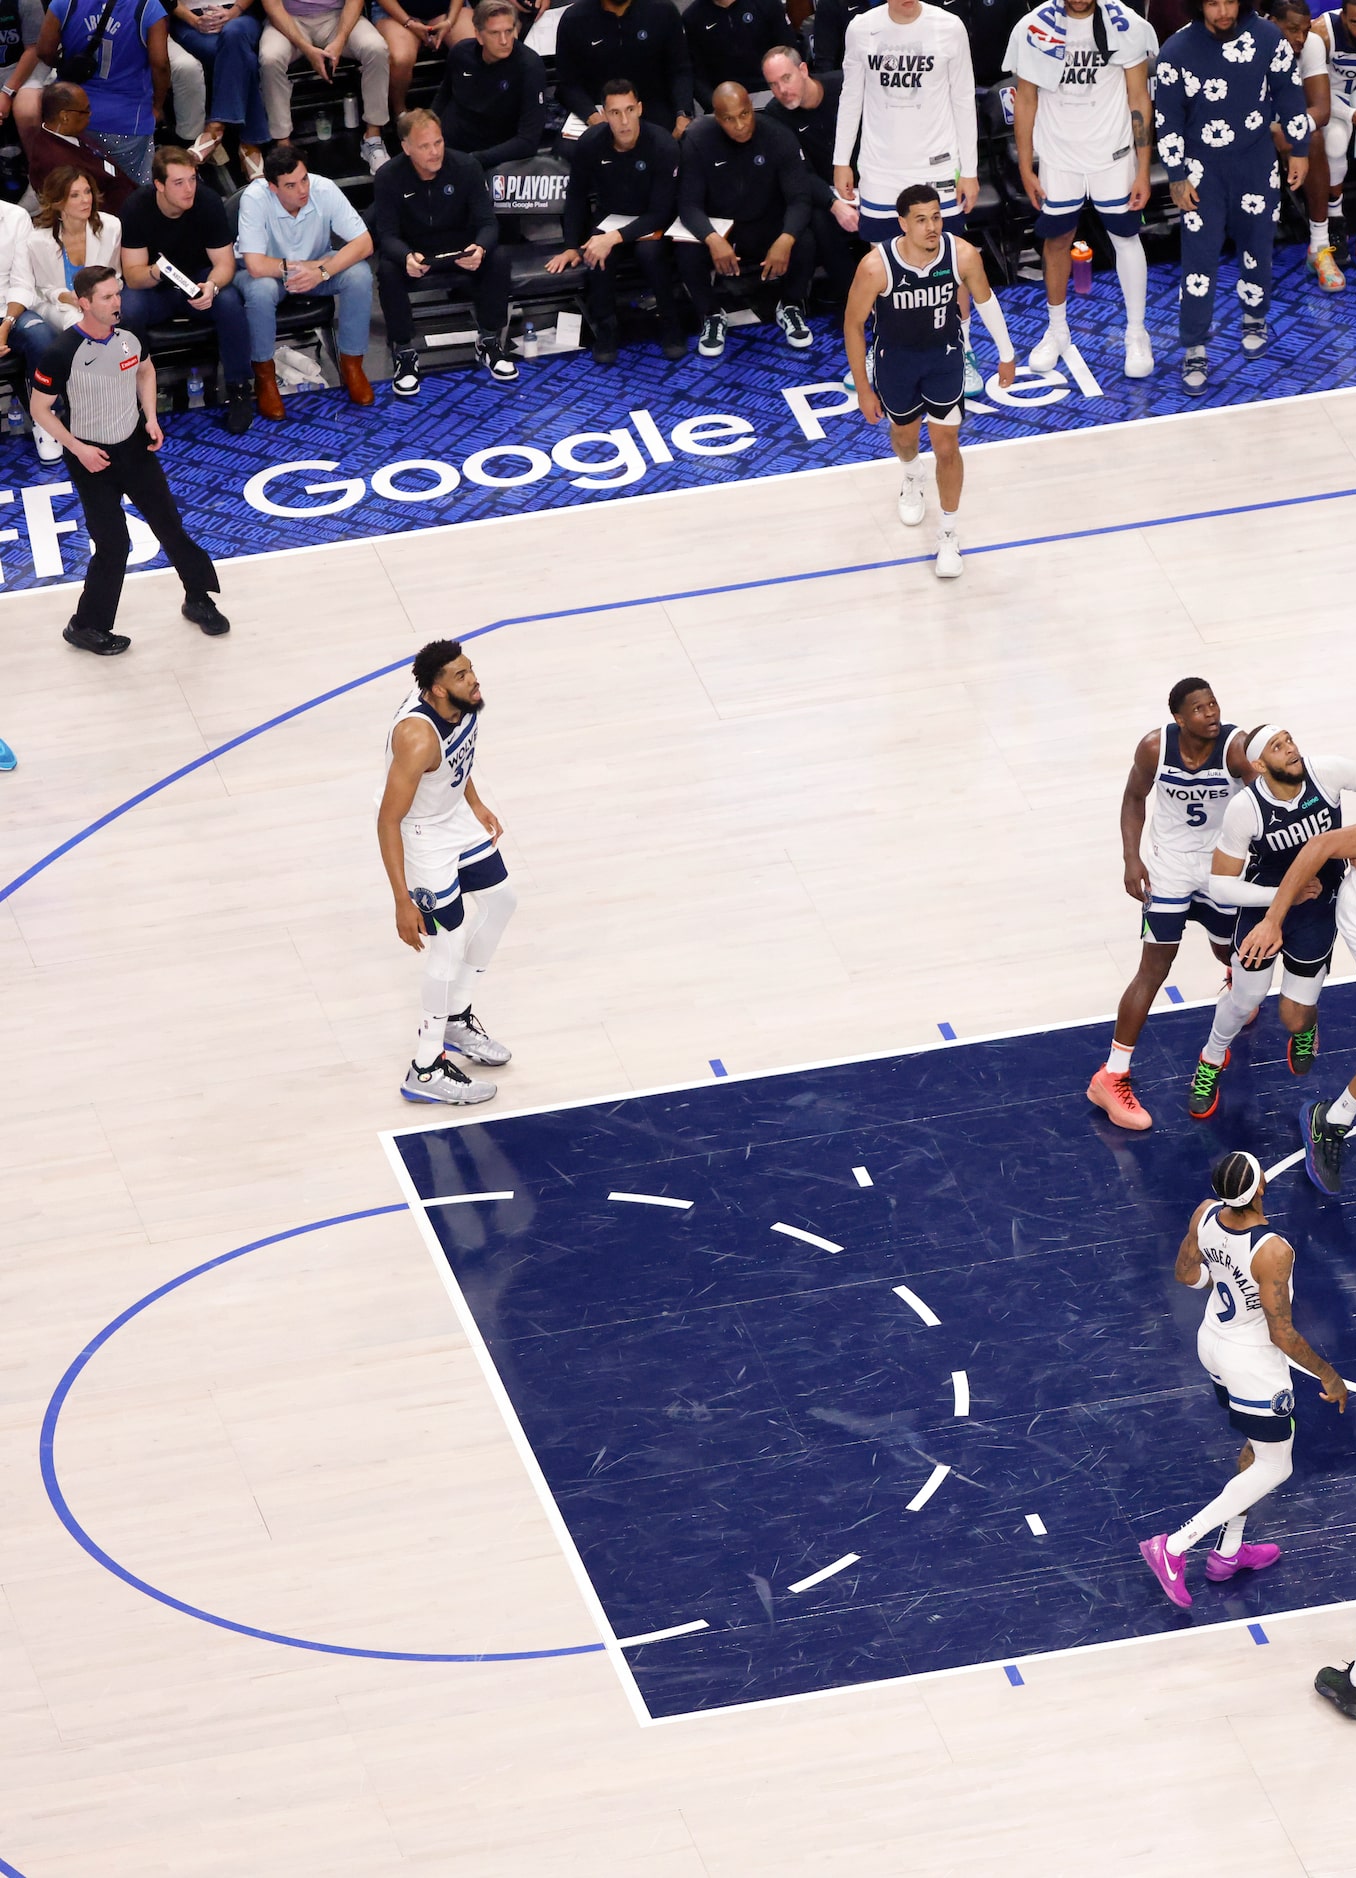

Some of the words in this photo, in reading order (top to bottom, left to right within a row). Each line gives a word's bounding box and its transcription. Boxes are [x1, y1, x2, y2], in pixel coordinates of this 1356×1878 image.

[868, 54, 935, 72] WOLVES
[880, 72, 922, 88] BACK
[506, 175, 570, 200] PLAYOFFS
[933, 269, 950, 277] chime
[934, 307, 946, 329] 8
[243, 409, 757, 518] Google
[781, 344, 1104, 441] Pel
[218, 520, 281, 546] KLEBER
[448, 727, 478, 769] WOLVE
[1186, 803, 1207, 827] 5
[1301, 796, 1320, 810] chime
[1216, 1282, 1236, 1323] 9
